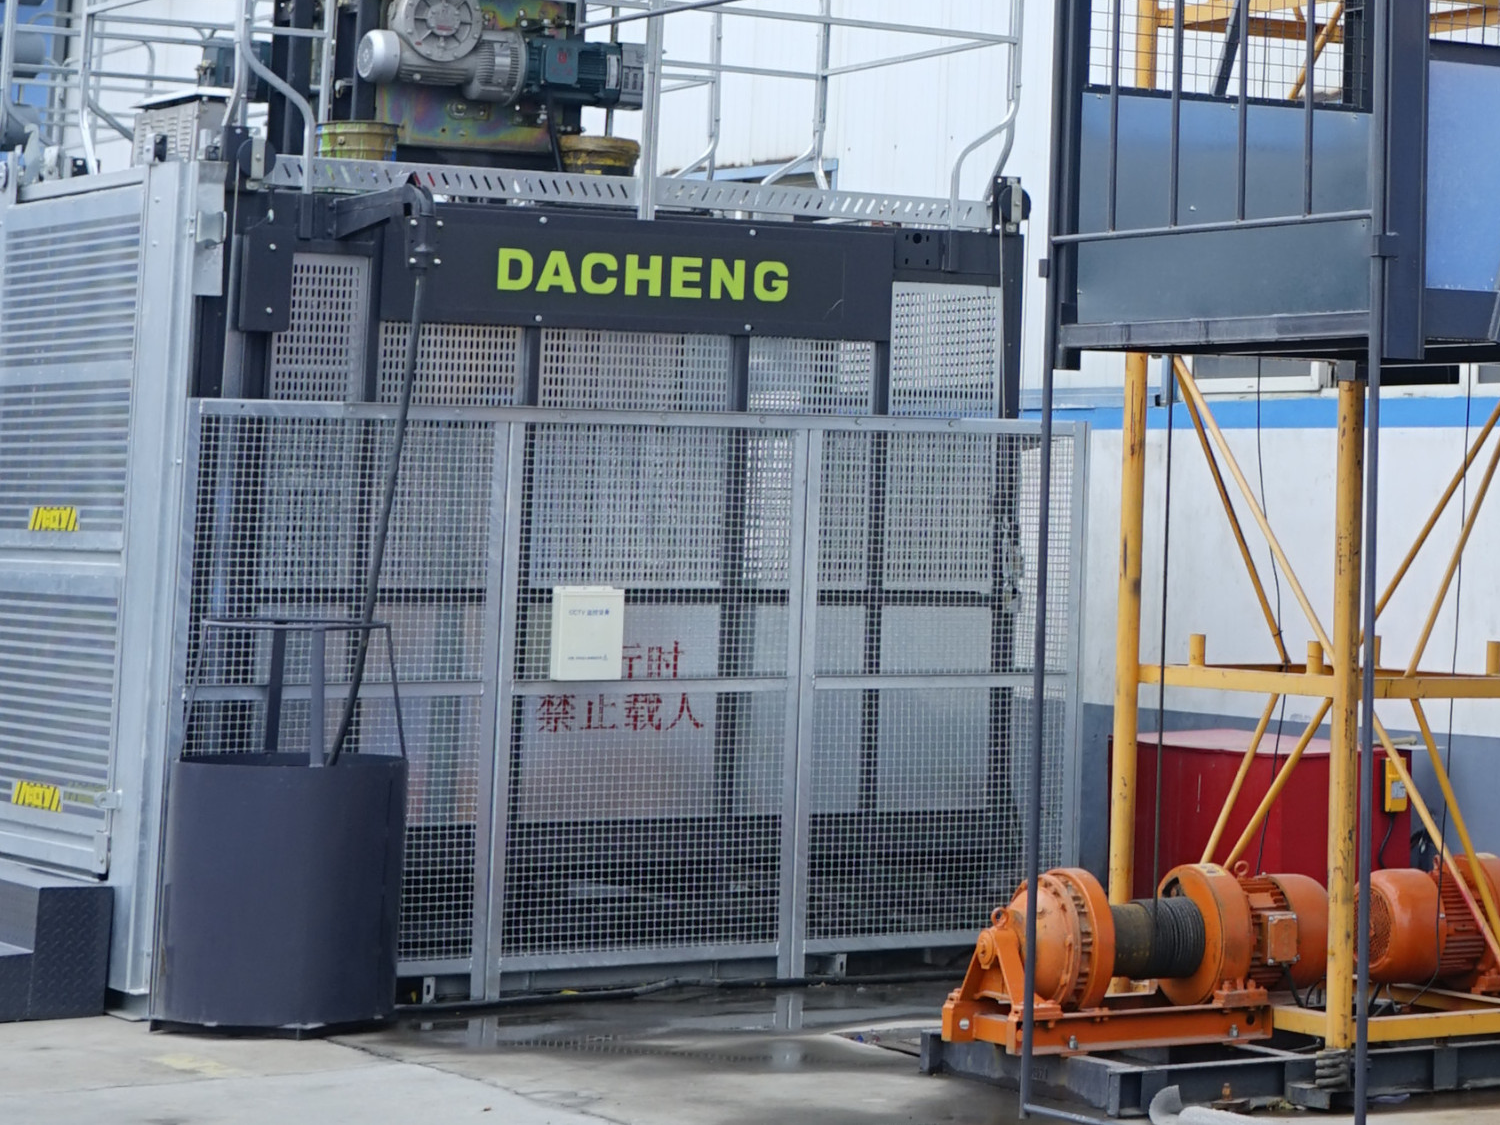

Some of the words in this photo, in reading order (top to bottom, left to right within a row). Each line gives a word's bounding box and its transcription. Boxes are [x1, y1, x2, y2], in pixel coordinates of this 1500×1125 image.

[496, 246, 791, 304] DACHENG
[536, 693, 705, 733] 禁止载人
